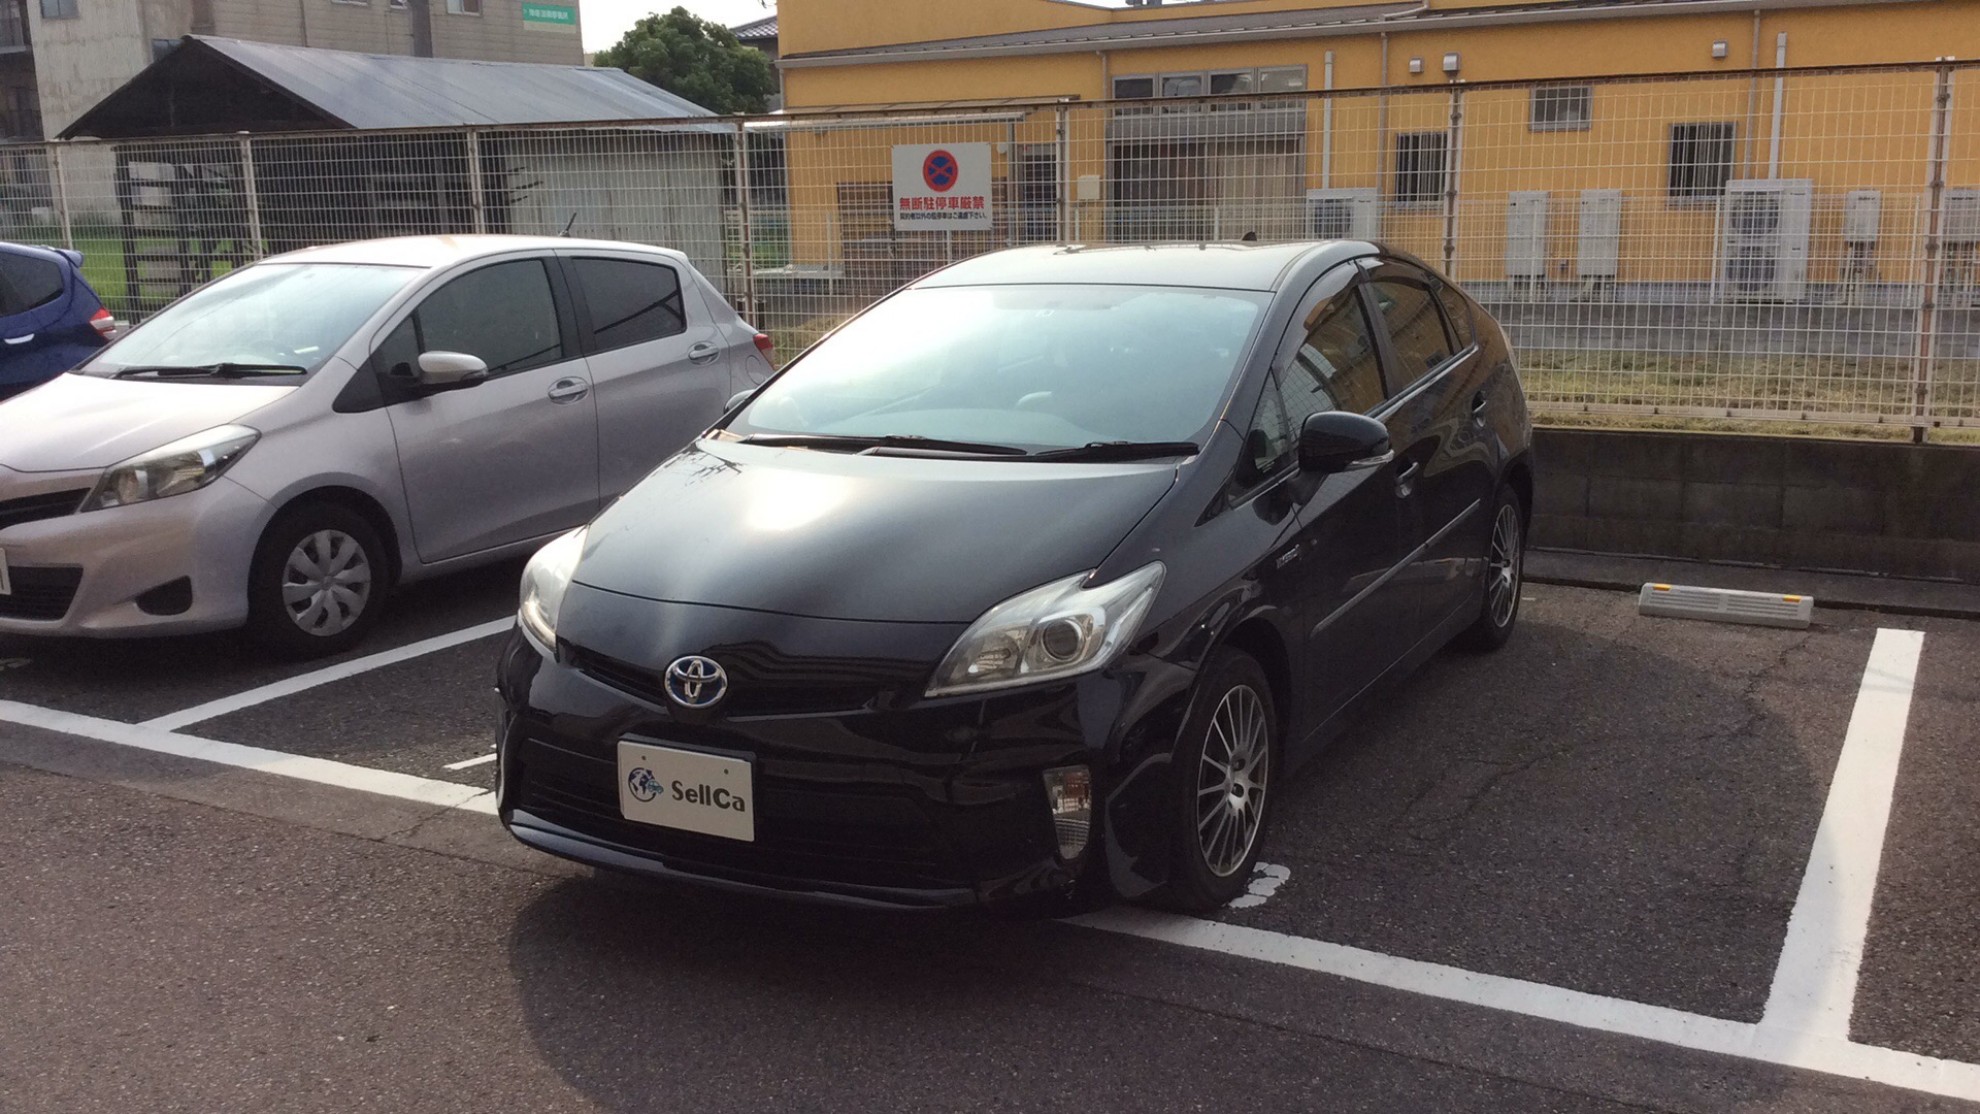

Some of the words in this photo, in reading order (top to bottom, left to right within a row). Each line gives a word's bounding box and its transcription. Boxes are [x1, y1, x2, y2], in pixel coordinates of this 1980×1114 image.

[900, 196, 985, 211] 無断駐停車厳禁
[672, 780, 745, 812] SellCa
